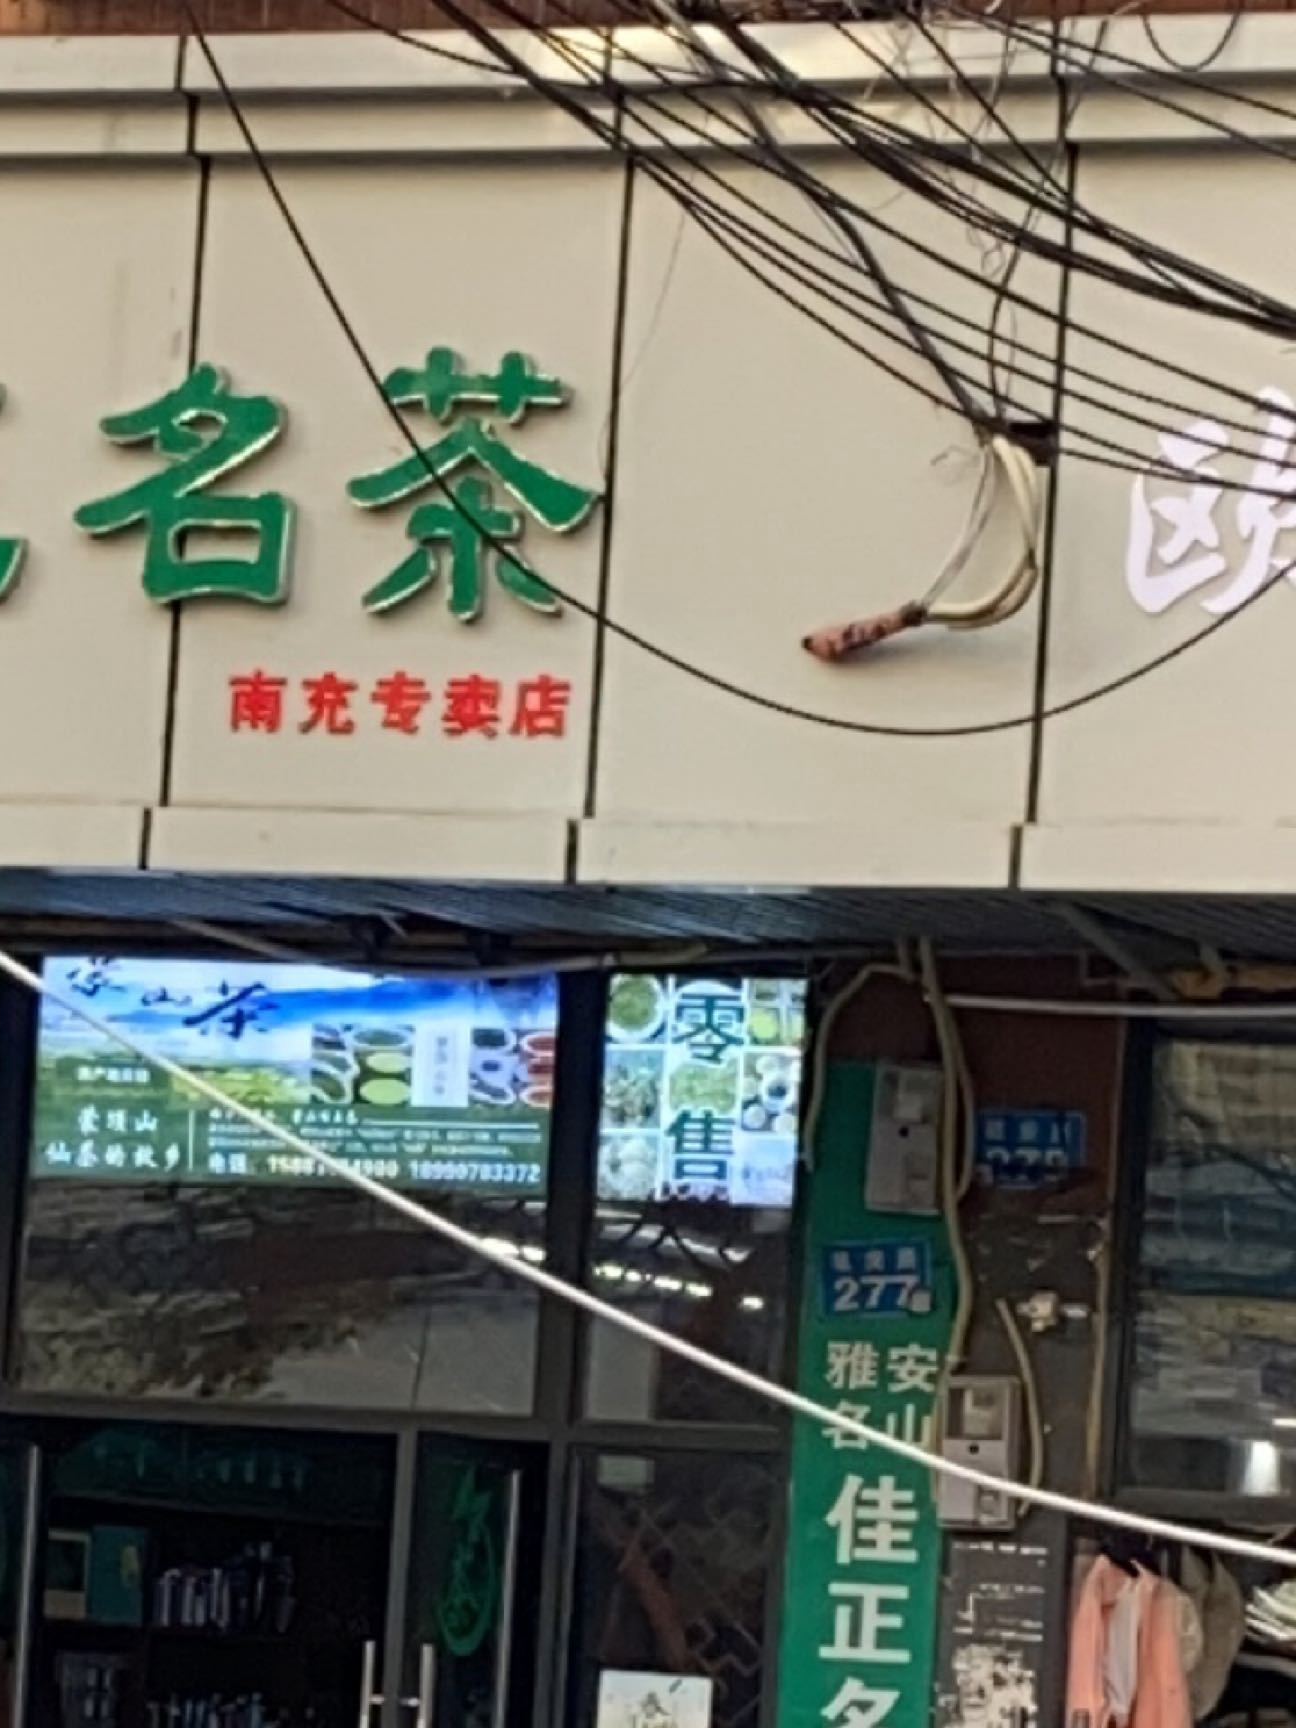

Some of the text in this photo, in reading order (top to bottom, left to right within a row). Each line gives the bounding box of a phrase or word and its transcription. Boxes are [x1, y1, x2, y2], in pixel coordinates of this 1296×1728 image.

[228, 669, 572, 740] 南充专卖店
[665, 992, 745, 1182] 零售
[832, 1274, 921, 1312] 277
[824, 1341, 938, 1392] 雅安
[821, 1399, 936, 1458] 名山
